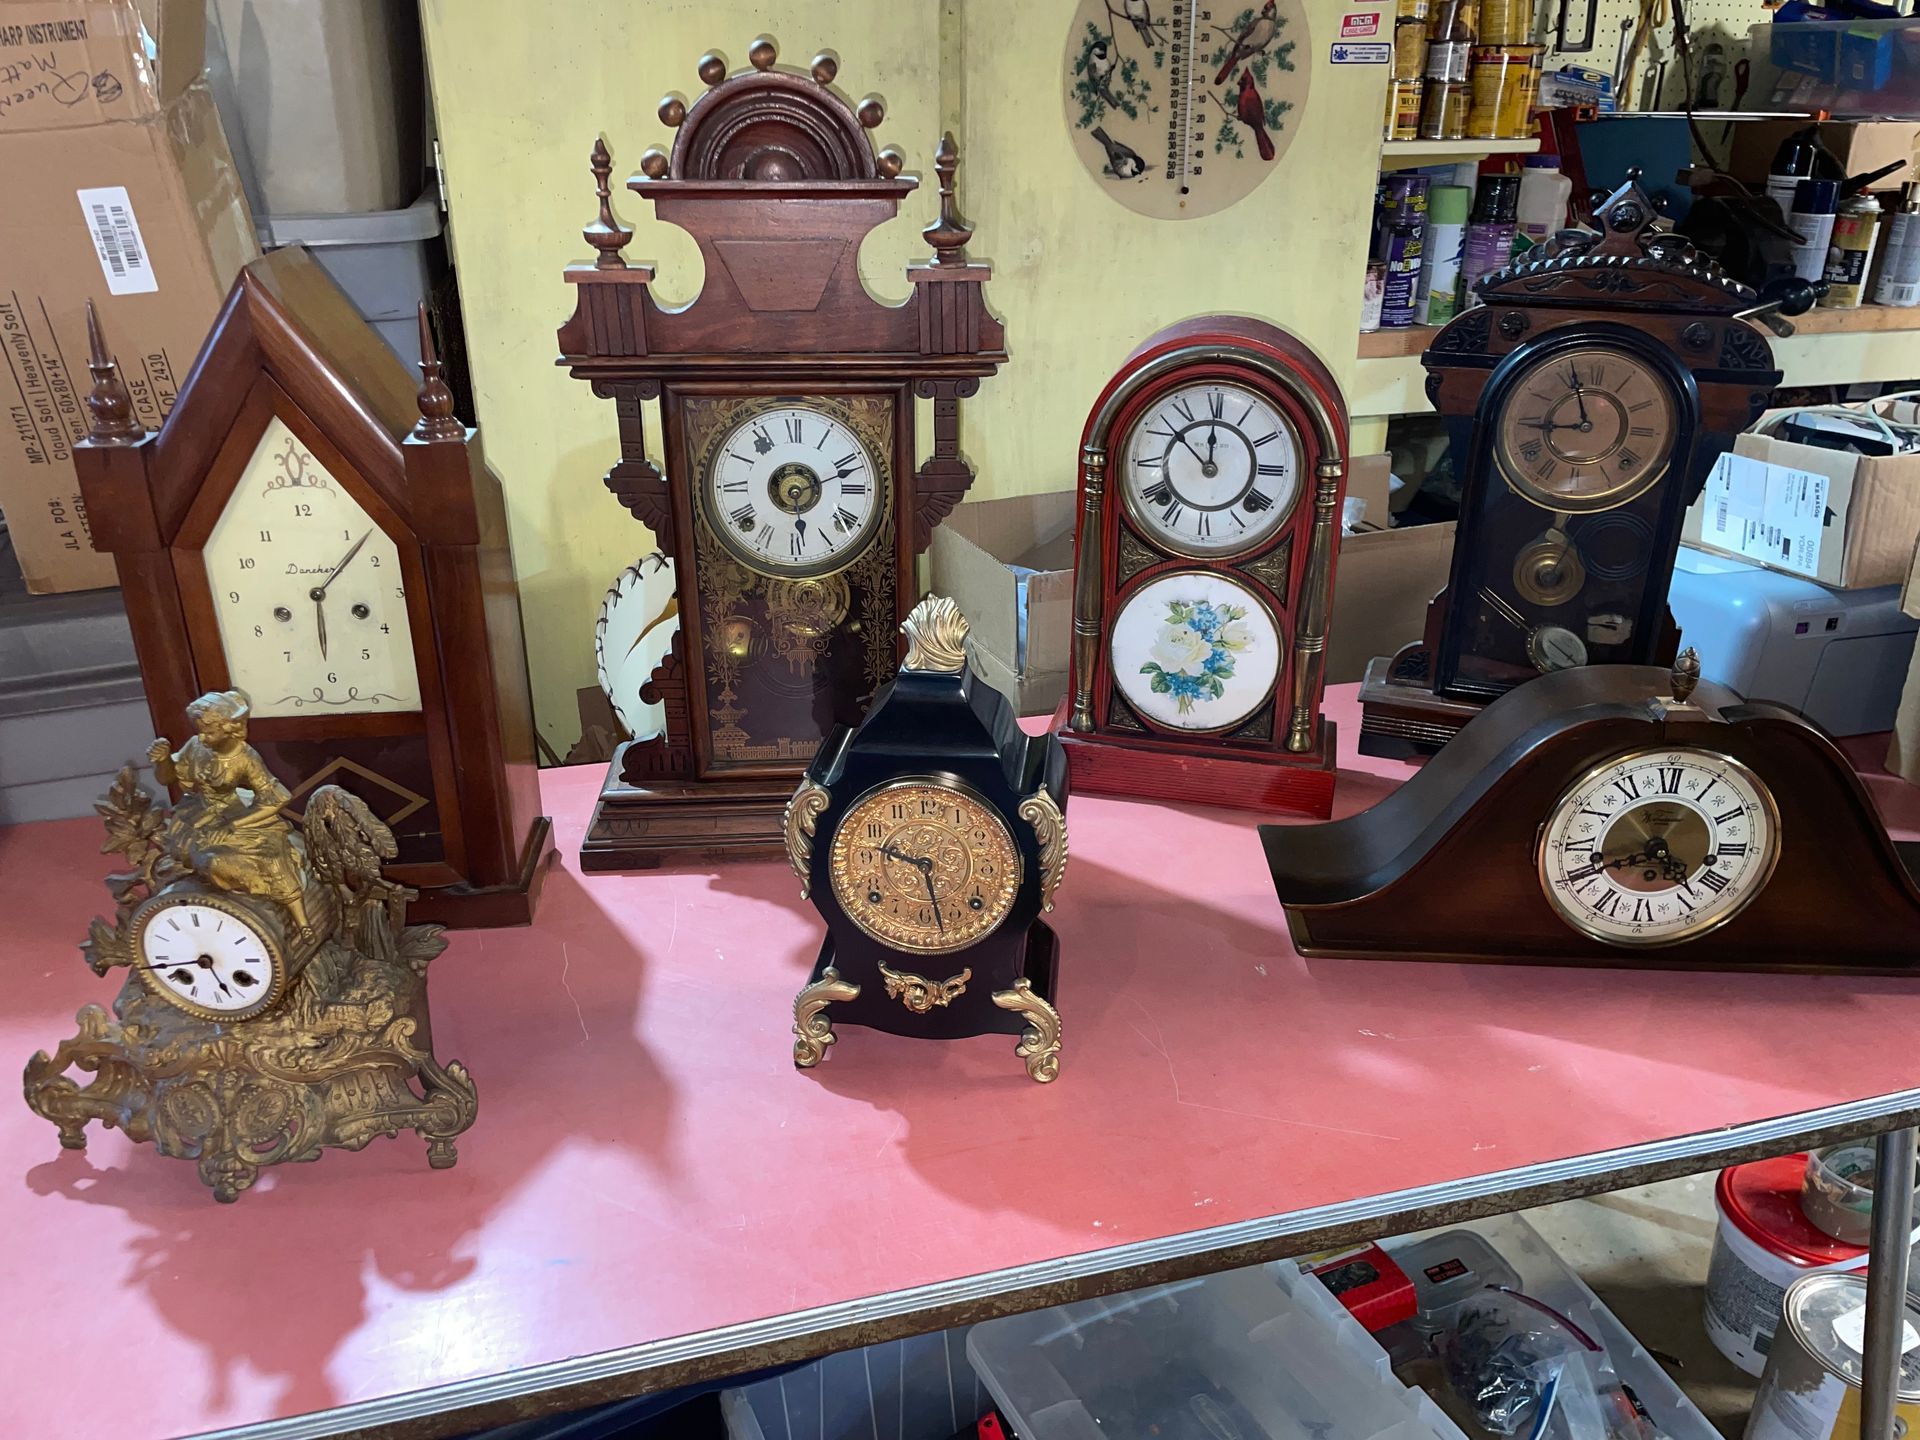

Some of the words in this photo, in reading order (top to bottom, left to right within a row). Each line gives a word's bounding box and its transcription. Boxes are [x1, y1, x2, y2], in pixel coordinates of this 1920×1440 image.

[1173, 5, 1182, 15] 90
[1202, 11, 1211, 20] 30
[1173, 19, 1182, 28] 80
[25, 19, 88, 44] INSTRUMENT
[1172, 31, 1181, 40] 70
[1201, 33, 1210, 42] 20
[1171, 44, 1181, 53] 60
[1171, 55, 1180, 65] 50
[1201, 54, 1209, 63] 10
[1170, 67, 1179, 76] 40
[1170, 77, 1179, 86] 30
[1200, 75, 1205, 84] 0
[1170, 89, 1179, 98] 20
[1198, 95, 1206, 104] 10
[1170, 100, 1178, 109] 10
[1172, 111, 1178, 120] 0
[1196, 114, 1205, 123] 20
[1169, 121, 1177, 129] 10
[1168, 132, 1177, 140] 20
[1195, 133, 1204, 141] 30
[1168, 141, 1176, 150] 30
[1168, 151, 1177, 160] 40
[1195, 150, 1204, 158] 40
[1167, 161, 1176, 170] 50
[1194, 166, 1202, 175] 50
[1166, 171, 1175, 180] 60
[10, 333, 42, 388] Heavenly
[148, 354, 170, 382] 2430
[159, 390, 175, 406] OF
[34, 398, 54, 424] Soft
[1205, 392, 1224, 419] XII
[10, 406, 44, 464] MP-211171
[784, 419, 805, 444] XII
[44, 427, 69, 461] Cloud
[1253, 431, 1280, 448] II
[1257, 464, 1285, 477] III
[841, 482, 866, 498] III
[294, 504, 312, 517] 12
[60, 531, 80, 550] JLA
[260, 531, 272, 543] 11
[344, 529, 351, 541] 1
[239, 558, 255, 570] 10
[371, 556, 381, 568] 2
[230, 591, 240, 604] 9
[395, 587, 405, 599] 3
[254, 625, 263, 638] 8
[380, 623, 390, 635] 4
[283, 651, 292, 663] 7
[361, 649, 370, 661] 5
[327, 672, 337, 684] 6
[1656, 768, 1687, 794] XII
[1613, 774, 1642, 805] XI
[1693, 778, 1719, 802] I
[892, 804, 904, 819] 11
[920, 800, 937, 815] 12
[1579, 801, 1613, 825] X
[955, 809, 961, 824] 1
[1713, 804, 1746, 826] II
[867, 823, 882, 838] 10
[974, 831, 986, 847] 2
[1564, 836, 1597, 853] IX
[1717, 841, 1747, 858] III
[861, 850, 873, 865] 9
[1592, 887, 1622, 917] VII
[1676, 893, 1696, 916] V
[919, 908, 932, 924] 6
[1631, 898, 1655, 922] VI
